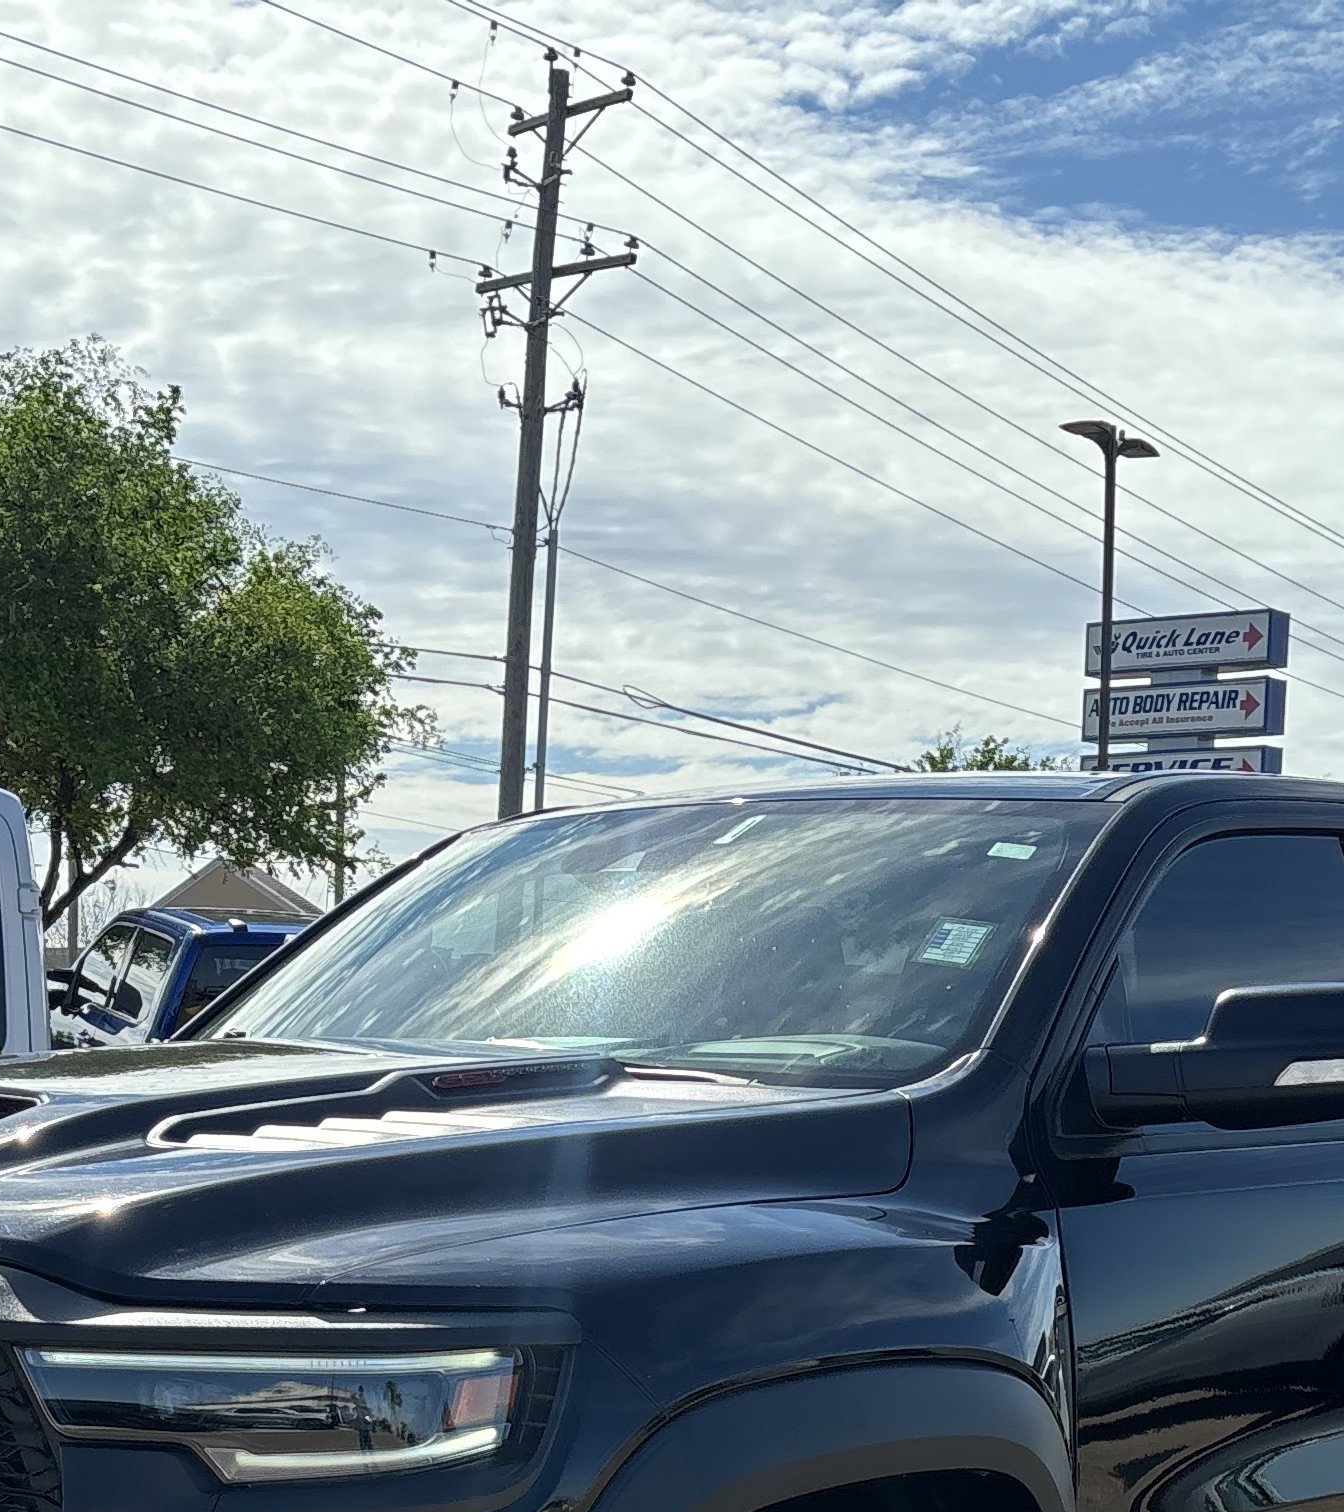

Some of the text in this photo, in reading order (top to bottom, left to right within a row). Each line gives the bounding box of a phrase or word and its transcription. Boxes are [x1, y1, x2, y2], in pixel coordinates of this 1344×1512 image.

[1121, 627, 1241, 653] Quick Lane
[1136, 651, 1153, 659] TIRE
[1163, 649, 1185, 657] AUTO
[1187, 647, 1221, 655] CENTER
[1088, 689, 1240, 717] ATO BODY REPAIR
[1118, 717, 1149, 727] Accept
[1152, 716, 1164, 725] All
[1166, 715, 1214, 724] Insurance
